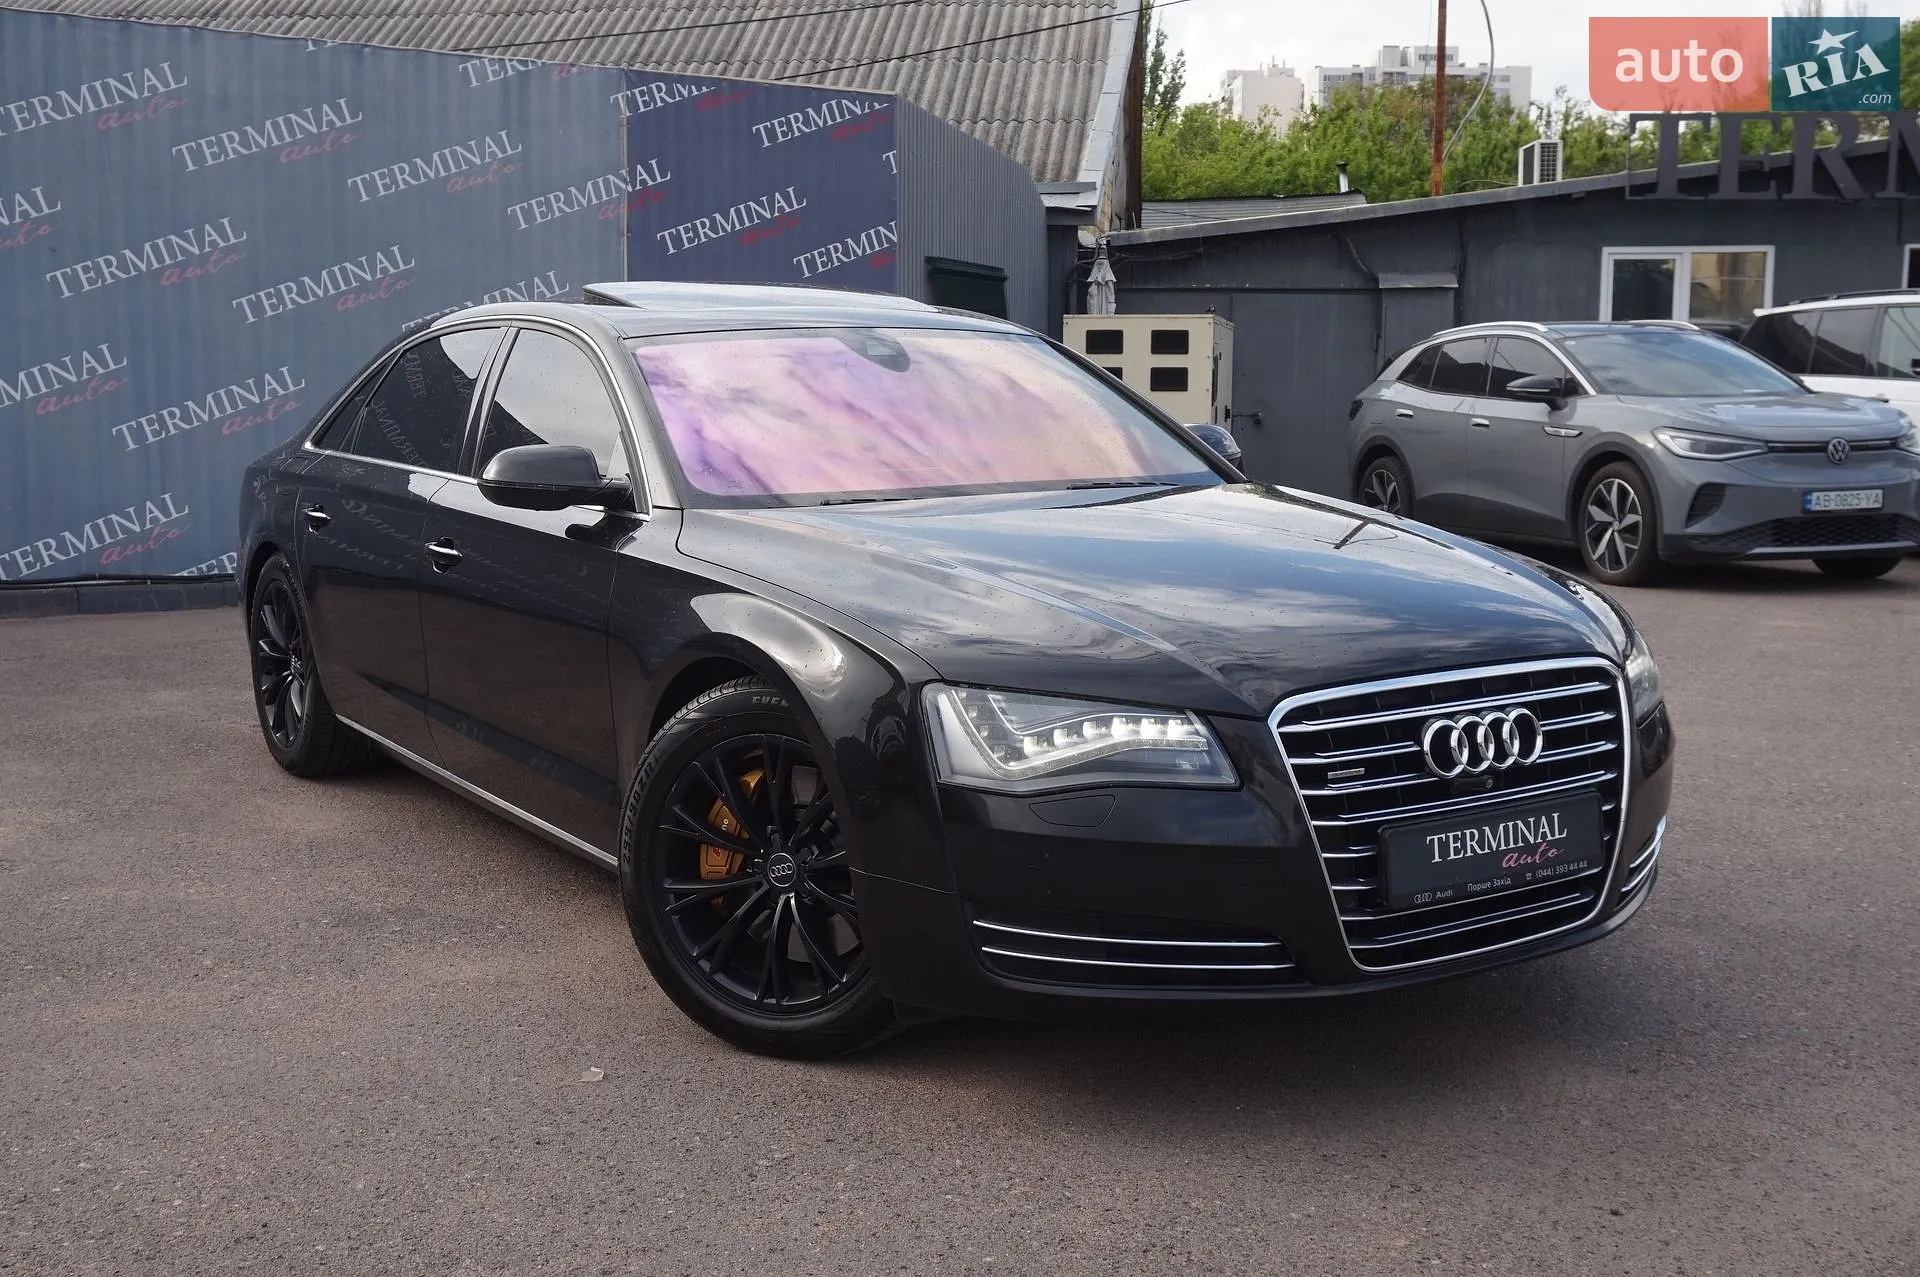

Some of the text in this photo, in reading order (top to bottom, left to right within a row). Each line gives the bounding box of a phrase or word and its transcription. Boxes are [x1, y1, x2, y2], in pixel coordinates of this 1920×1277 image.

[97, 97, 188, 130] auto
[172, 98, 363, 172] TERMINAL
[279, 130, 363, 164] auto
[347, 129, 521, 202] TERMINAL
[446, 162, 522, 194] auto
[508, 159, 671, 230] TERMINAL
[657, 186, 807, 255] TERMINAL
[46, 217, 247, 299] TERMINAL
[160, 250, 248, 286] auto
[232, 245, 415, 324] TERMINAL
[336, 277, 415, 312] auto
[35, 377, 128, 415] auto
[112, 366, 305, 451] TERMINAL
[221, 397, 306, 437] auto
[101, 524, 191, 565] auto
[1427, 813, 1567, 863] TERMINAL
[1502, 841, 1563, 870] auto
[1467, 882, 1491, 893] Порше
[1535, 860, 1588, 880] (044) 393 44 44
[1436, 889, 1453, 899] Audi
